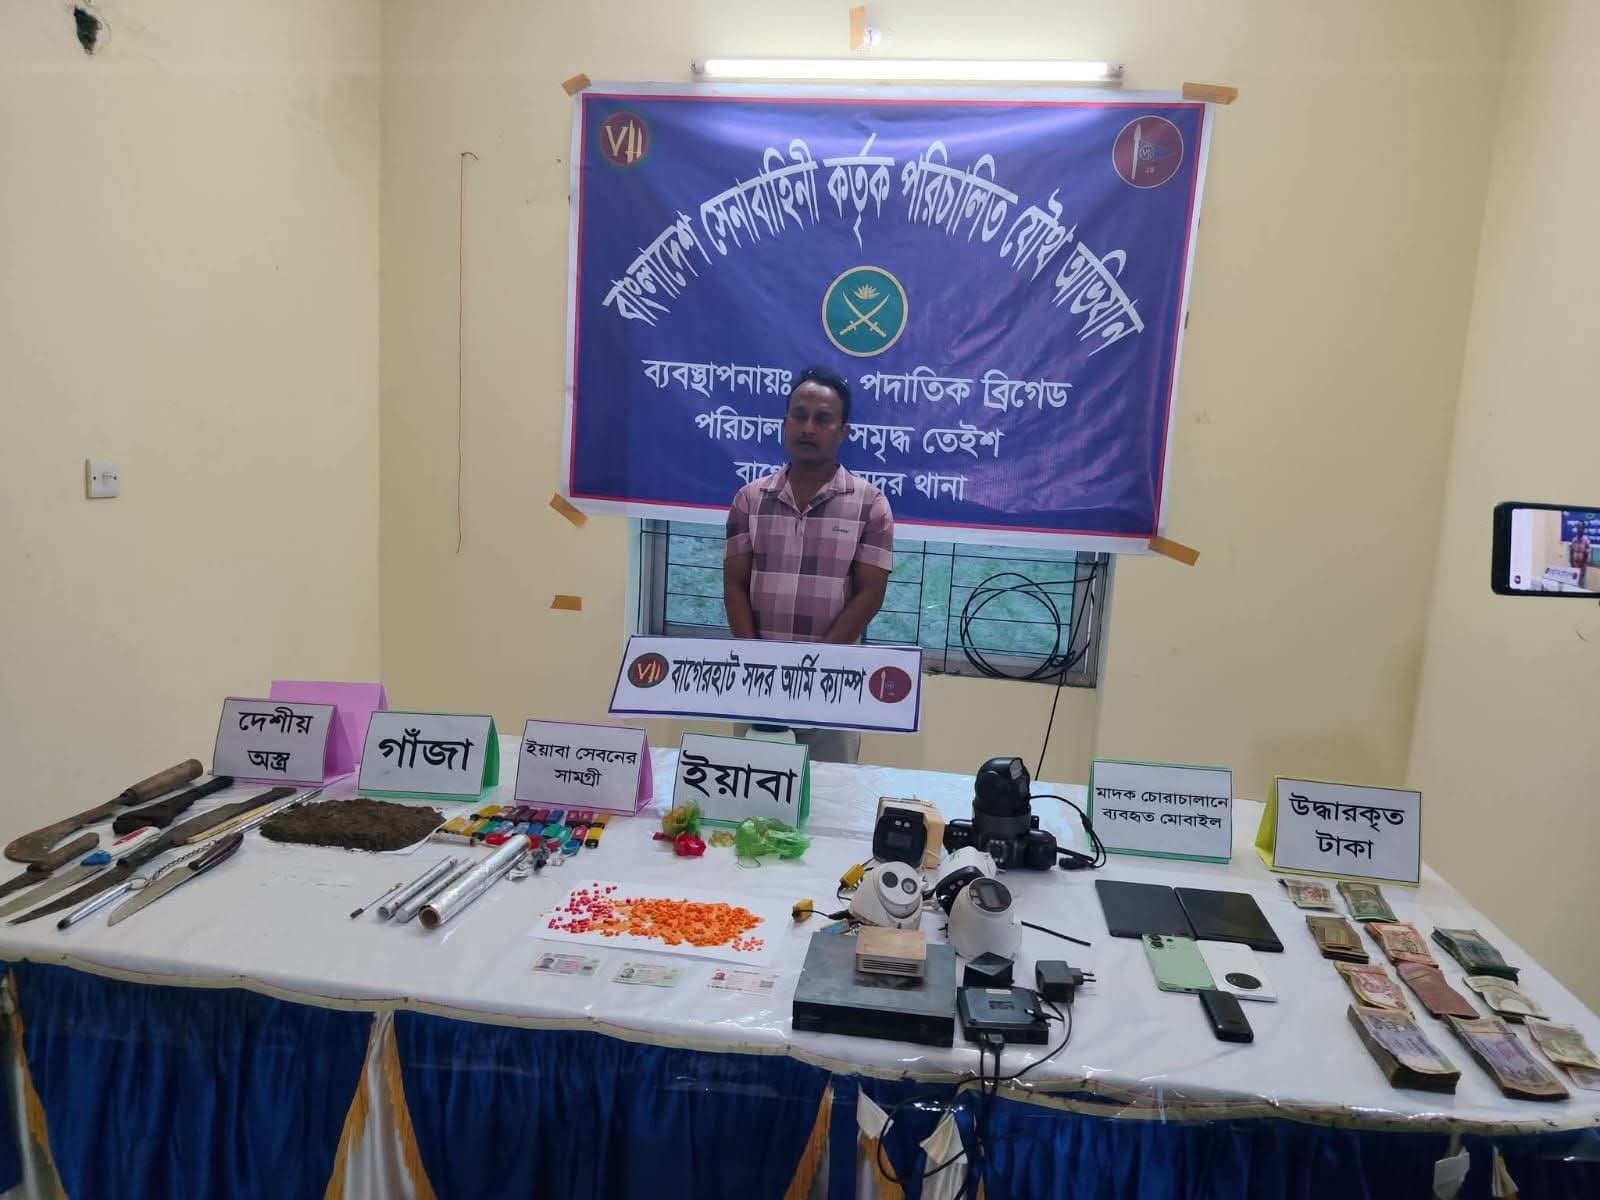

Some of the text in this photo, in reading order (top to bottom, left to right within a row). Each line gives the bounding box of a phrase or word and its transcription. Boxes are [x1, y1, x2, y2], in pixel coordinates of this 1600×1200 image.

[602, 132, 1145, 357] বাংলাদেশ সেনাবাহিনী কর্তৃক পরিচালিত যৌথ অভিযান
[641, 359, 1073, 411] ব্যবস্থাপনায়ঃ পদাতিক ব্রিগেড
[848, 422, 914, 463] সমৃদ্ধ
[922, 420, 1005, 458] তেইশ
[914, 472, 968, 501] থানা
[671, 649, 740, 695] বাগেরহাট
[742, 663, 777, 698] সদর
[780, 652, 820, 701] আর্মি
[820, 667, 867, 704] ক্যাম্প
[239, 706, 314, 735] দেশীয়
[247, 750, 291, 773] অস্ত্র
[378, 728, 475, 771] গাঁজা
[525, 738, 638, 765] ইয়াবা সেবনের
[554, 766, 603, 787] সামগ্রী
[682, 749, 800, 804] ইয়াবা
[1096, 786, 1229, 809] মাদক চোরাচালানে
[1288, 792, 1406, 831] উদ্ধারকৃত
[1102, 807, 1222, 830] ব্যবহৃত মোবাইল
[1315, 829, 1374, 860] টাকা
